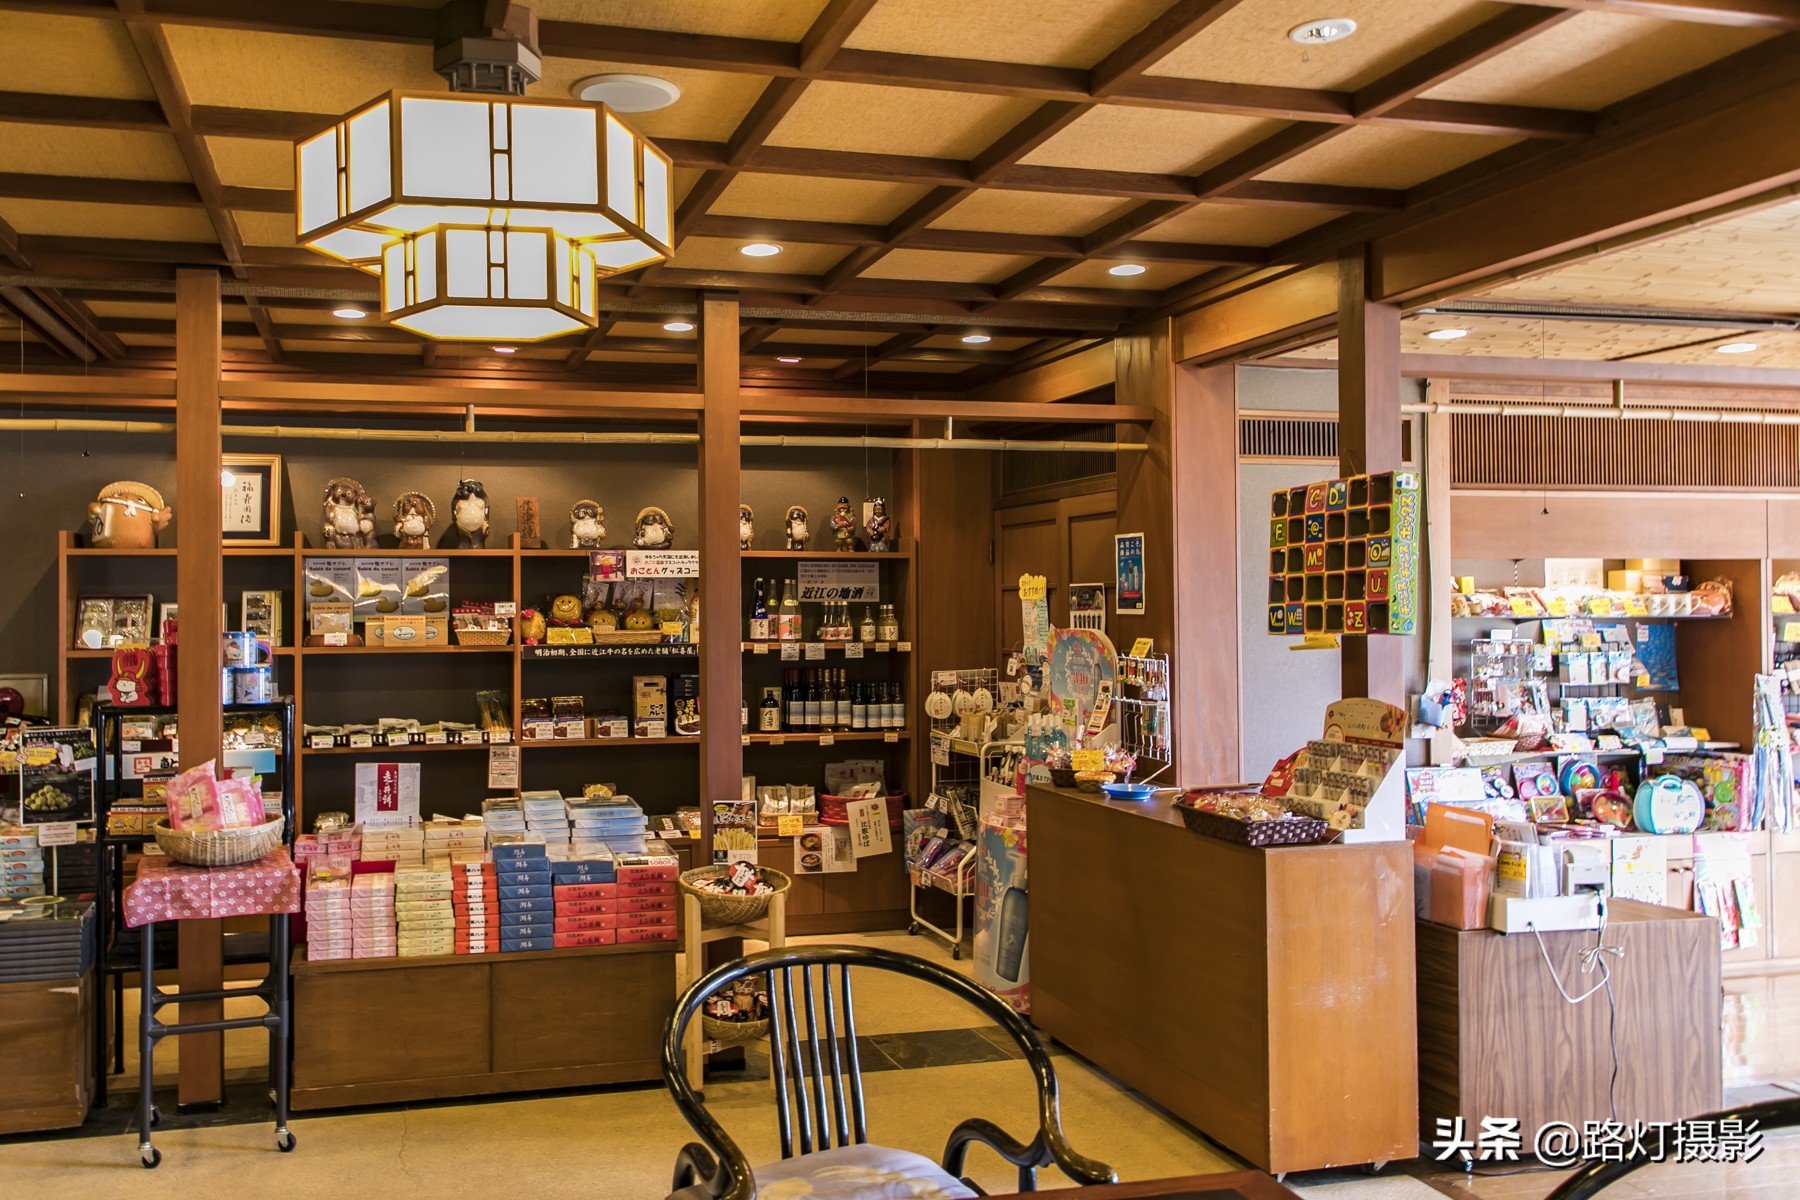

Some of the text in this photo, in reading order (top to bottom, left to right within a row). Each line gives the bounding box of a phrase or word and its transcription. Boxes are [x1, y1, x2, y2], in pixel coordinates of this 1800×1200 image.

[801, 586, 864, 599] 近江の地酒
